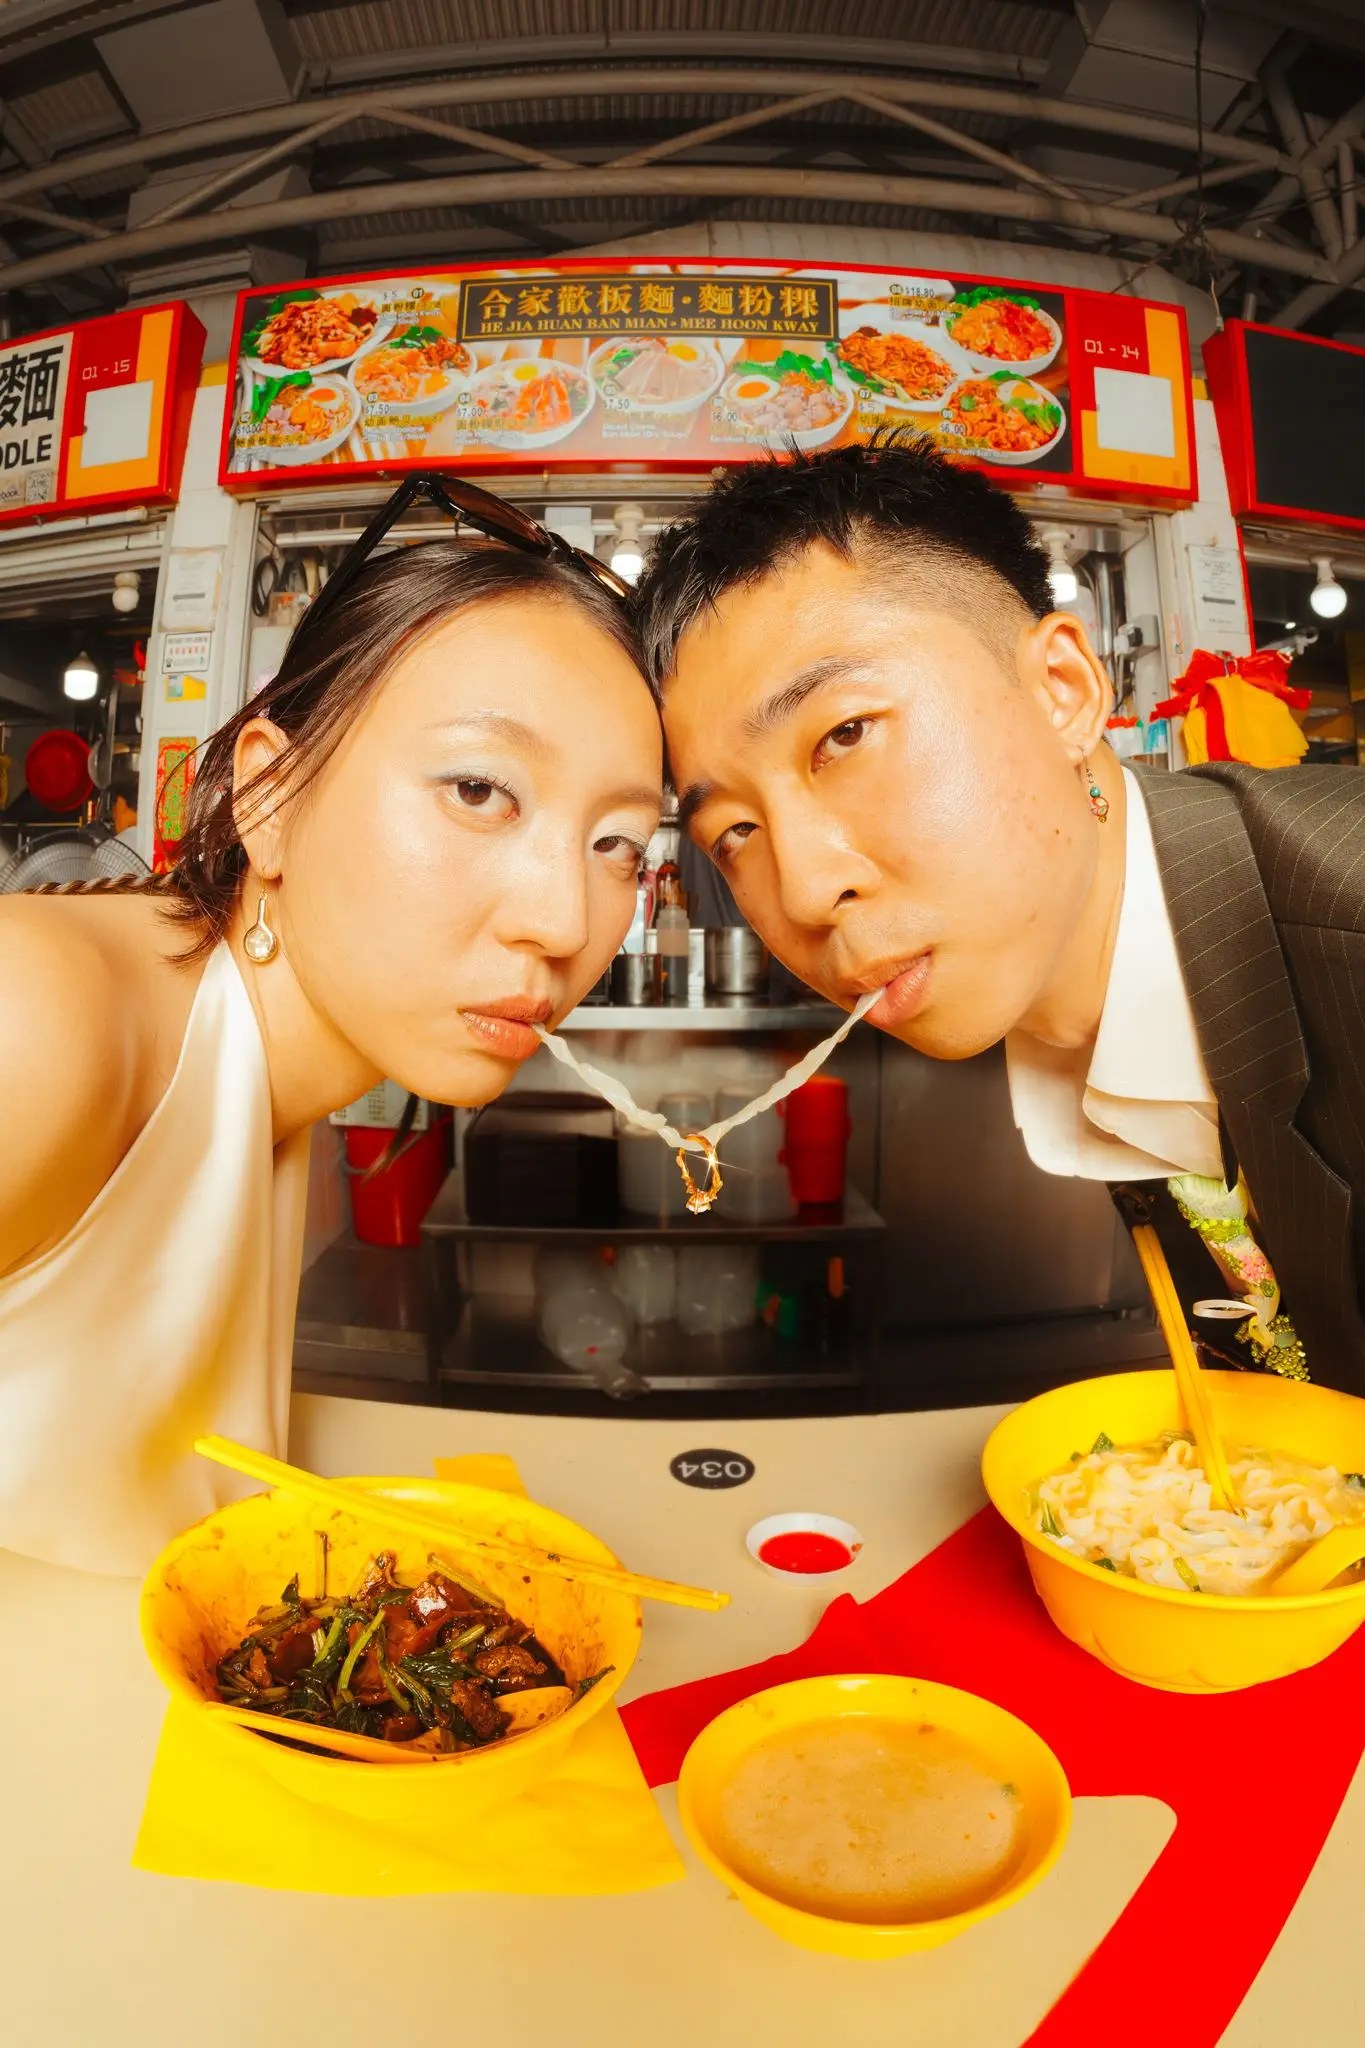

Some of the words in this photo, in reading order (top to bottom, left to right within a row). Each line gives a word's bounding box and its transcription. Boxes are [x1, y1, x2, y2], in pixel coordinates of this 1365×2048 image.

[480, 321, 503, 334] HE
[507, 320, 533, 332] JIA
[537, 319, 583, 330] HUAN
[587, 318, 620, 329] BAN
[625, 317, 668, 329] MIAN
[680, 317, 716, 329] MEE
[721, 318, 768, 331] HOON
[772, 319, 820, 333] KWAY
[0, 434, 53, 470] DLE
[677, 1460, 747, 1479] 034
